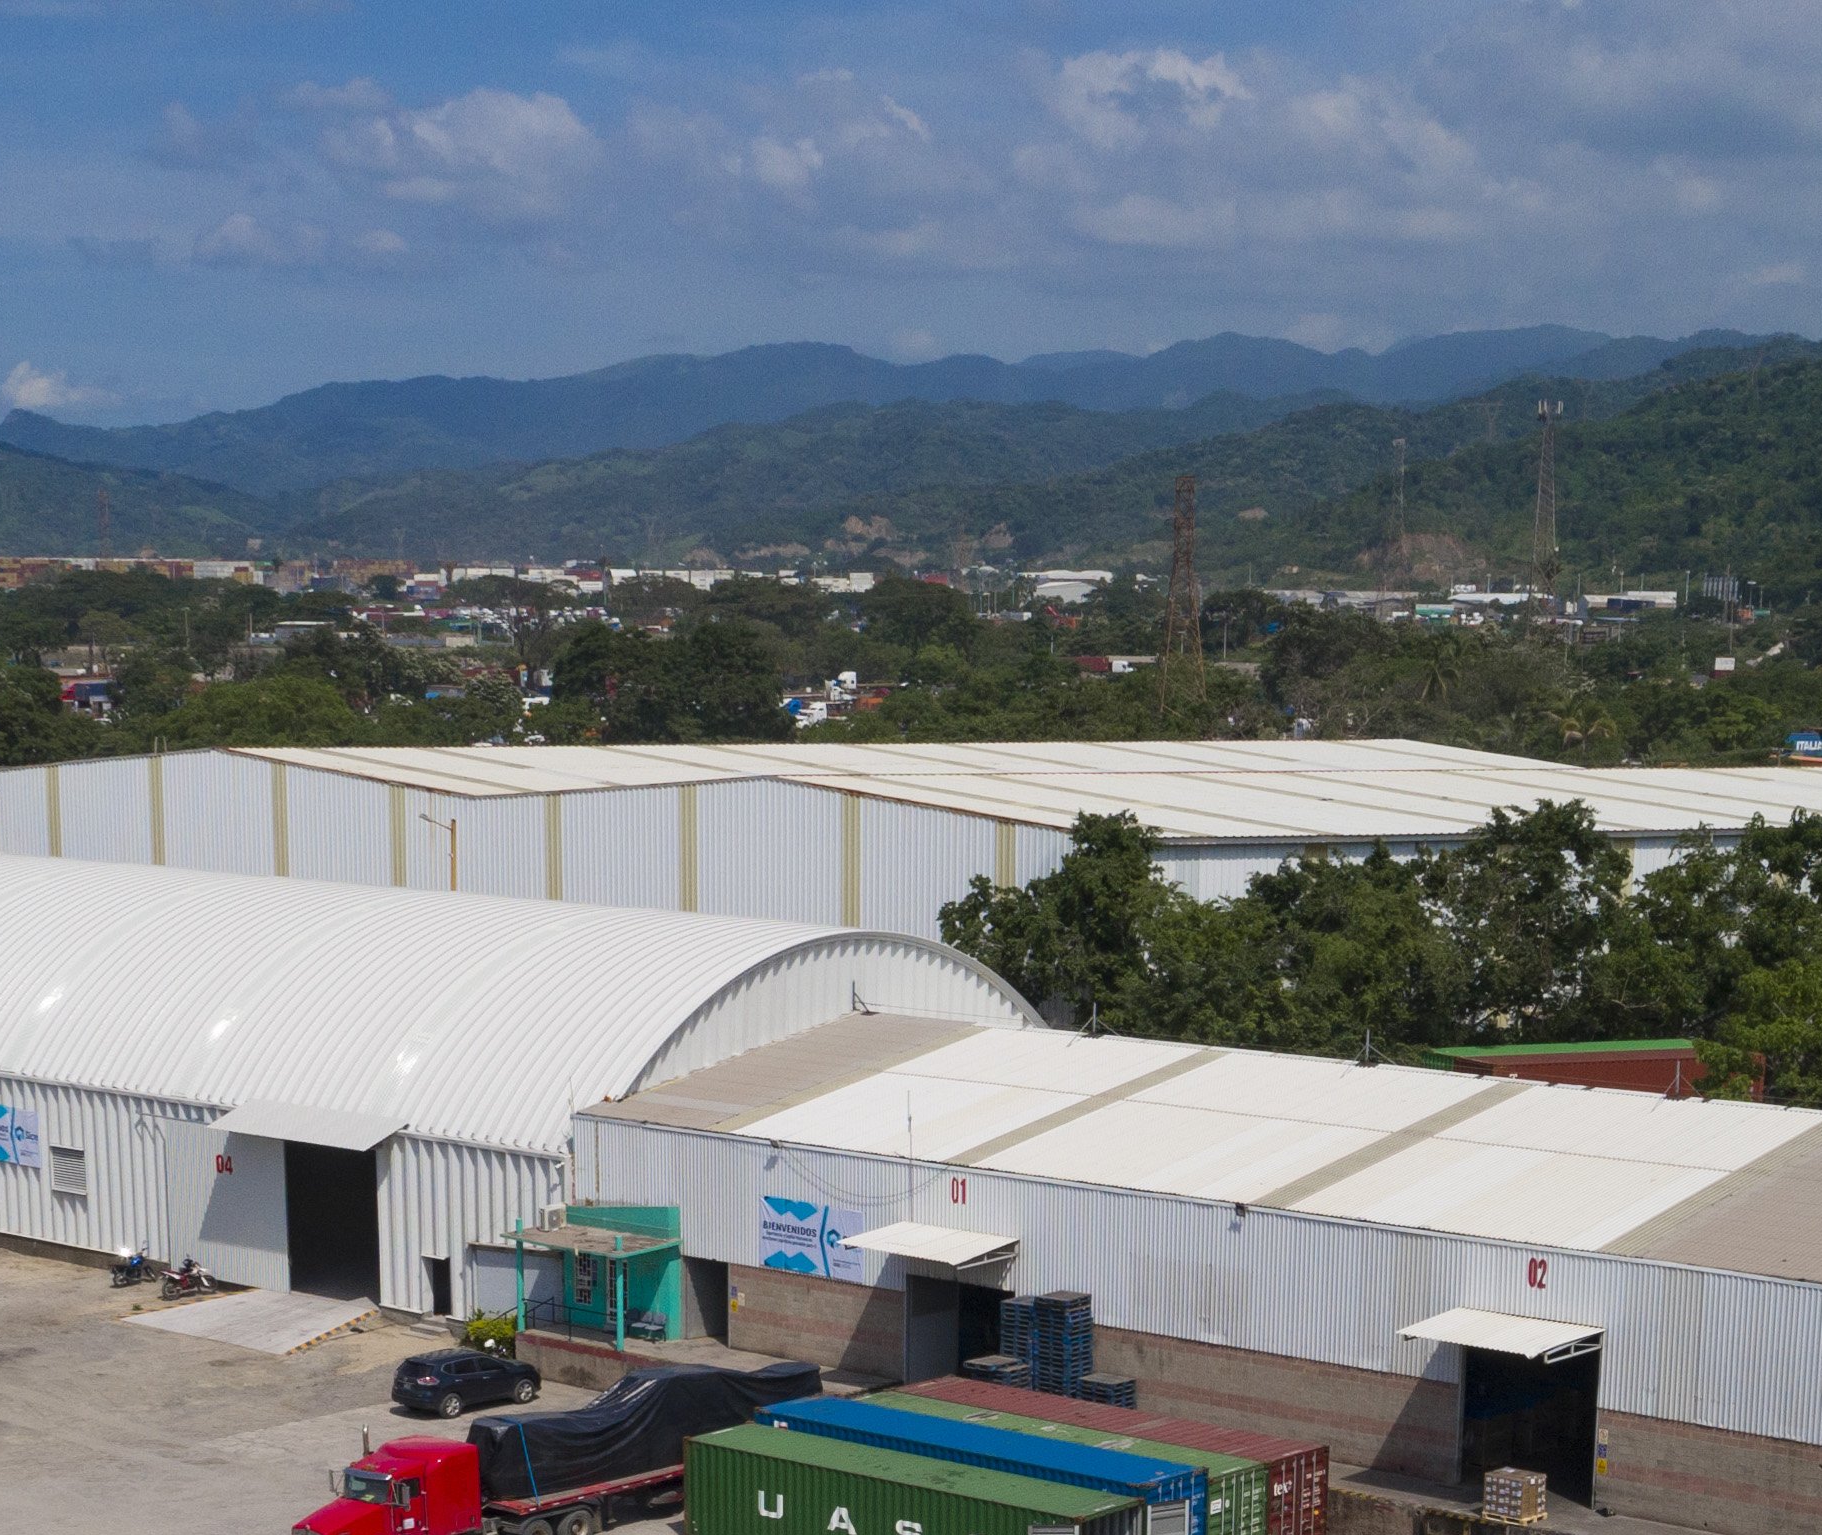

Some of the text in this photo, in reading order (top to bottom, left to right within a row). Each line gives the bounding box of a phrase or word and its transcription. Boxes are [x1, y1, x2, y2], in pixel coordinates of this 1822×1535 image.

[1796, 740, 1822, 751] ITALIA
[216, 1154, 233, 1175] 04
[951, 1176, 966, 1205] 01
[762, 1220, 817, 1238] BIENVENIDOS
[1528, 1257, 1547, 1289] 02
